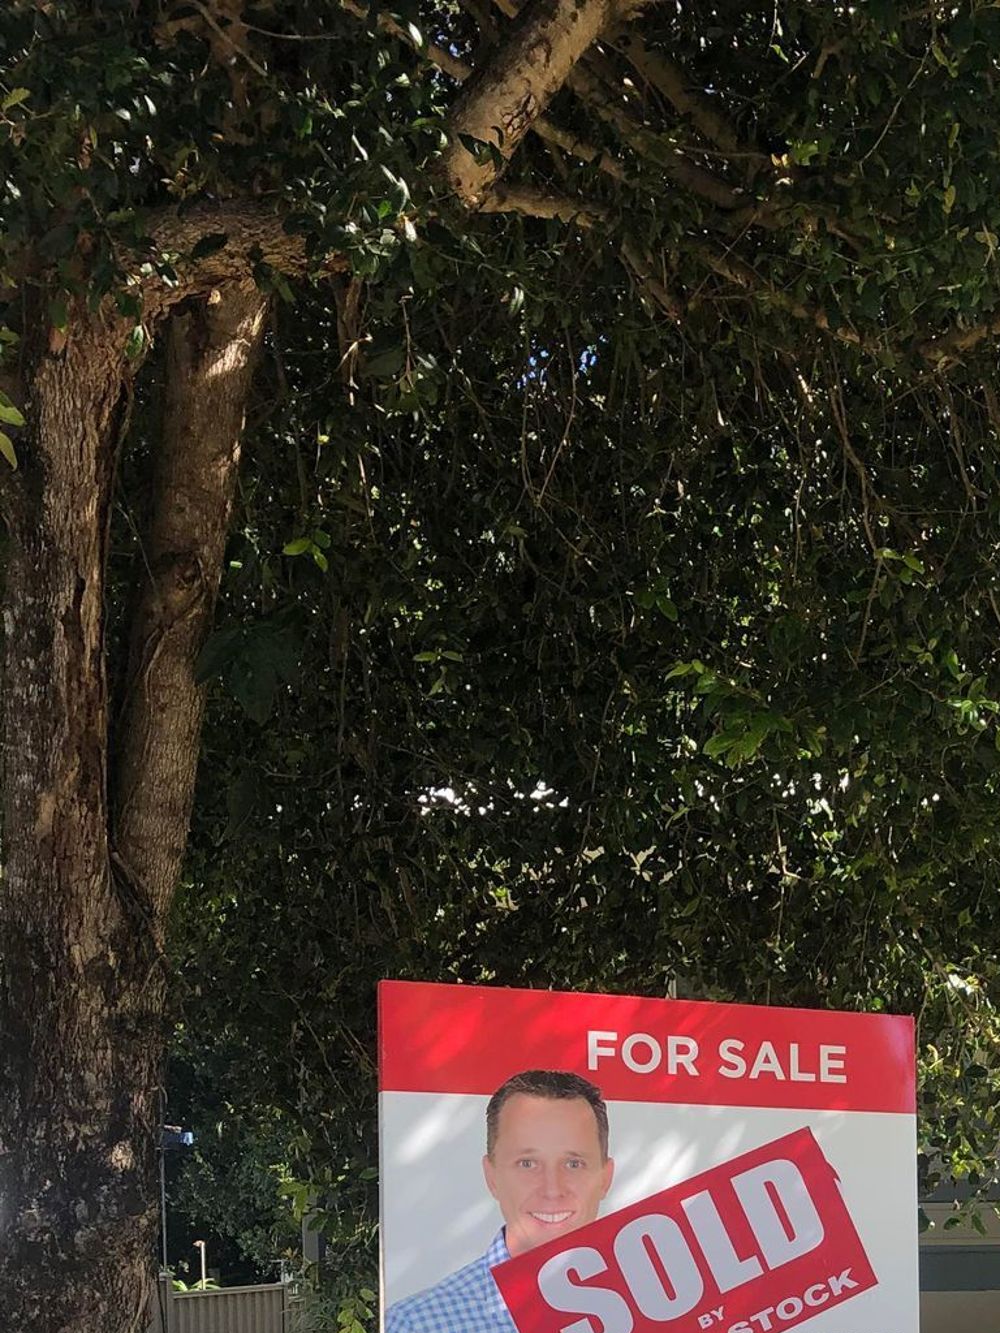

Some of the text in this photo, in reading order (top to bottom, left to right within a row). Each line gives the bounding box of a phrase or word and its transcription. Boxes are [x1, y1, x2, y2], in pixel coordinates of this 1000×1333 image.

[586, 1030, 847, 1083] FOR SALE
[698, 1306, 725, 1329] BY
